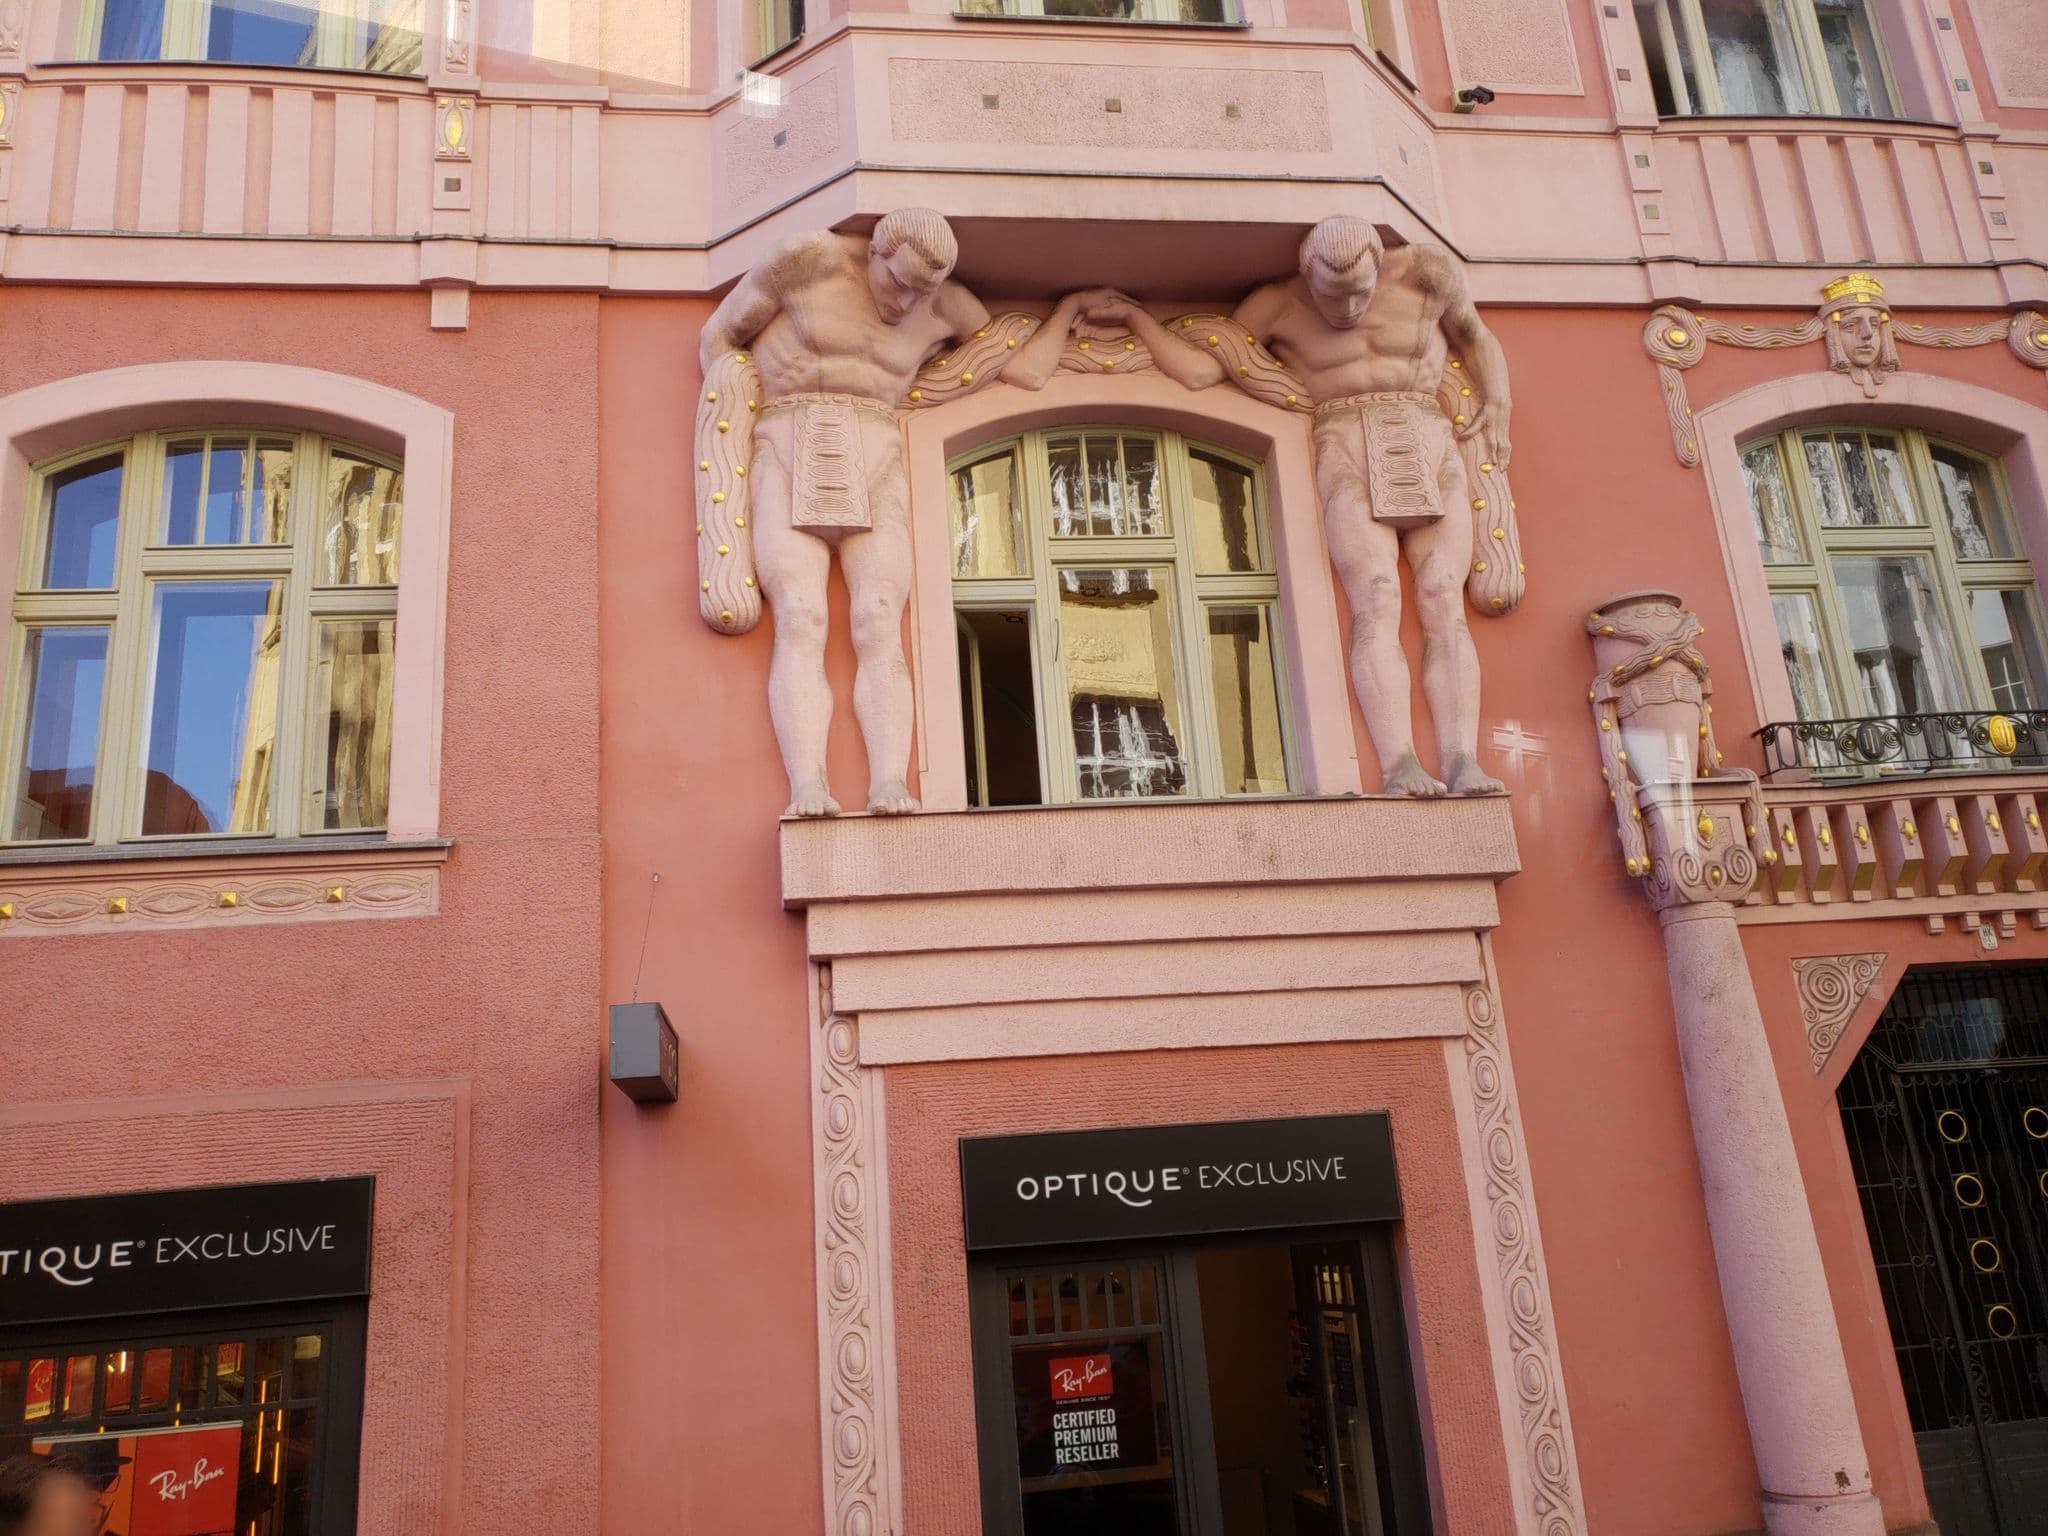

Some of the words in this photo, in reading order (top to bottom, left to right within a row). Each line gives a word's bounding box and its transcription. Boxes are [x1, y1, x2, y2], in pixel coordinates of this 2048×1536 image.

[1016, 1167, 1183, 1208] OPTIQUE
[1199, 1157, 1347, 1189] EXCLUSIVE
[155, 1225, 336, 1264] EXCLUSIVE
[1054, 1359, 1107, 1393] Ray-Ban
[1053, 1408, 1116, 1430] CERTIFIED
[1054, 1426, 1117, 1447] PREMIUM
[1056, 1443, 1120, 1465] RESELLER
[149, 1457, 226, 1501] Ray-Ban
